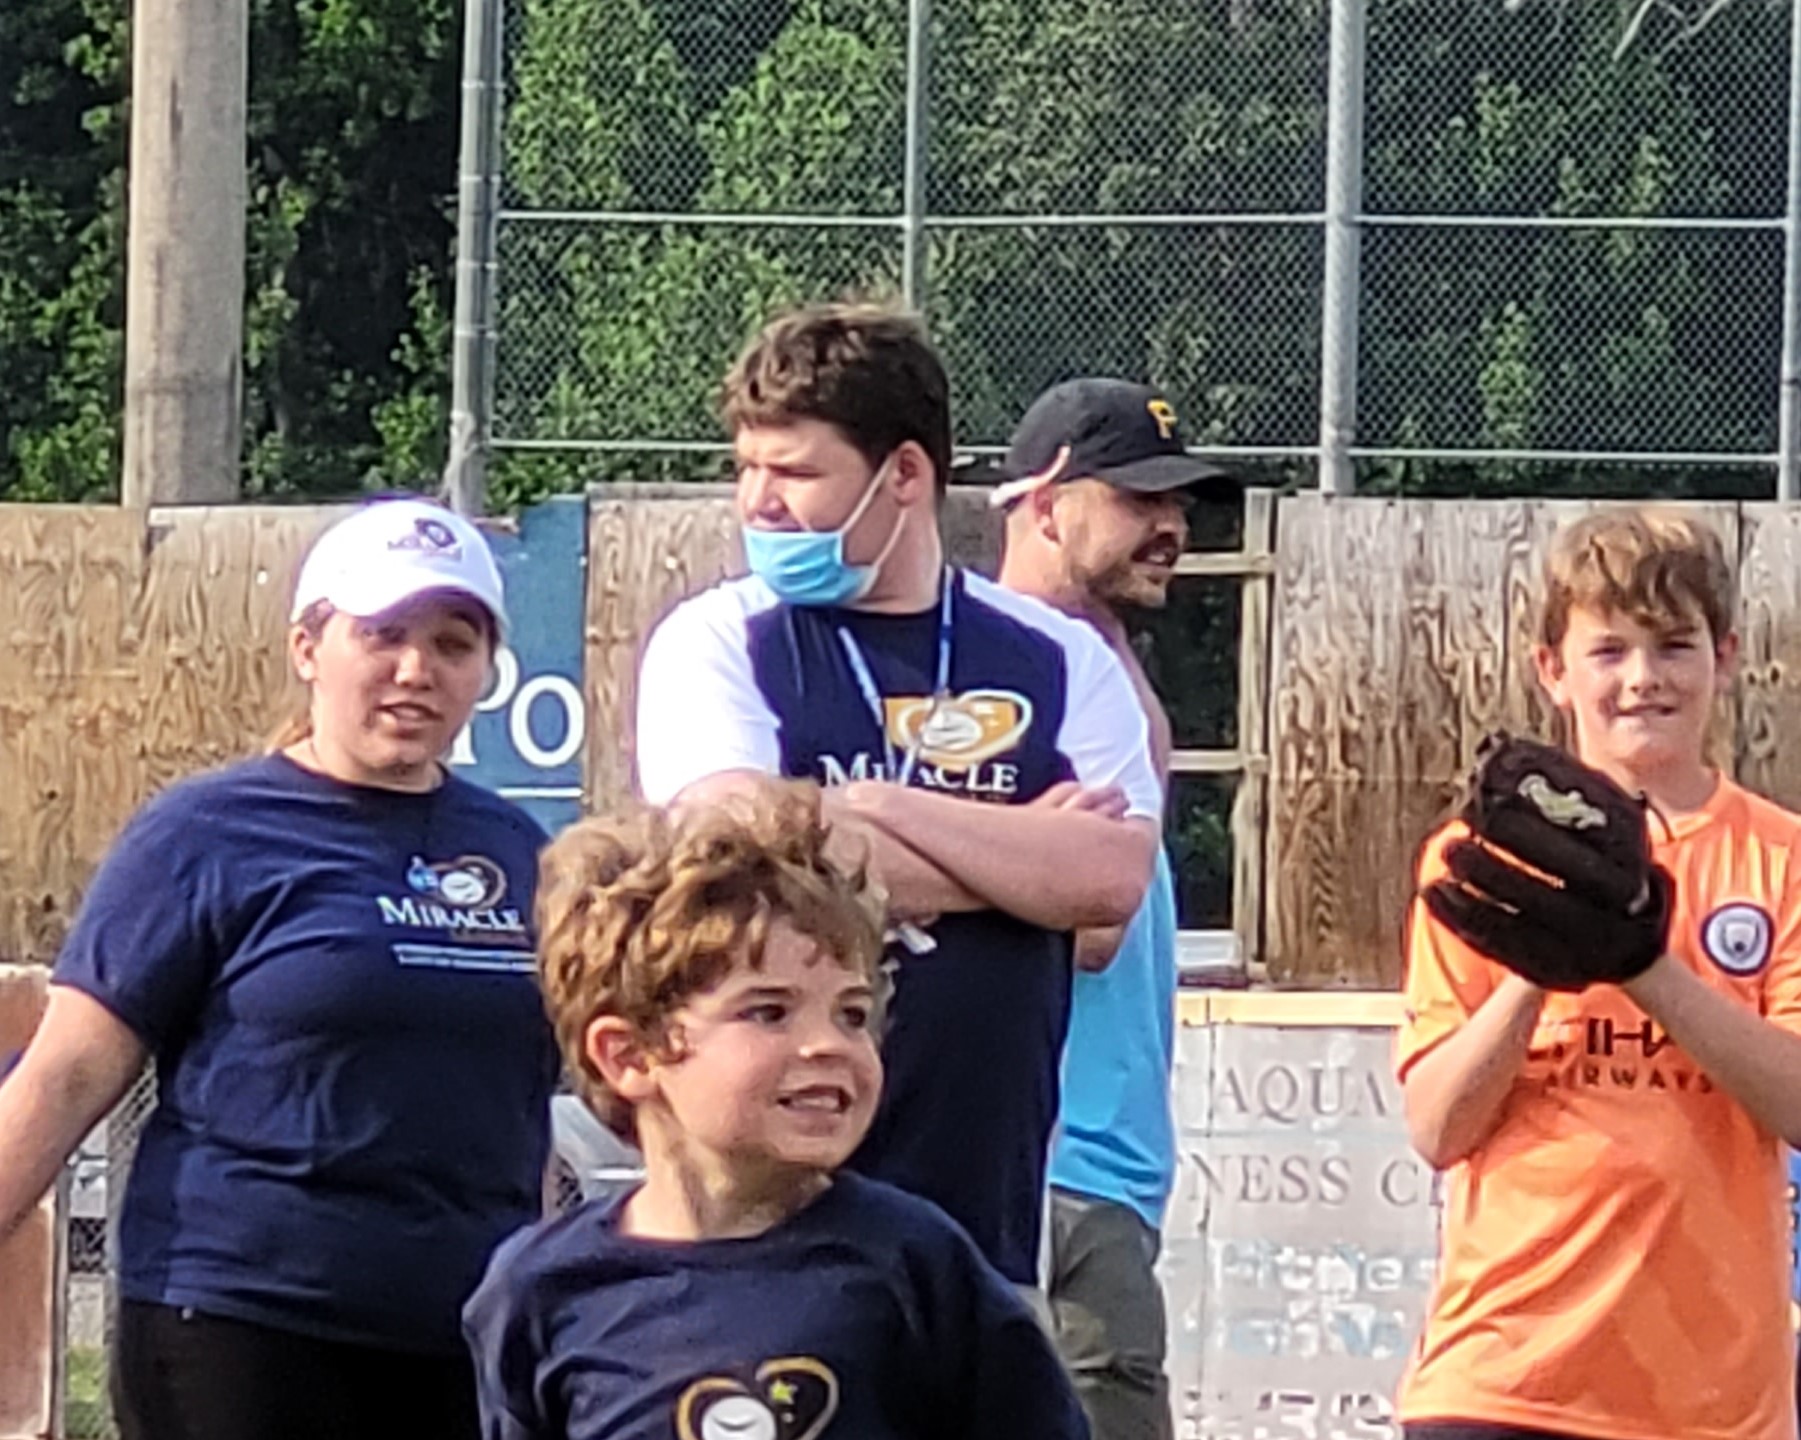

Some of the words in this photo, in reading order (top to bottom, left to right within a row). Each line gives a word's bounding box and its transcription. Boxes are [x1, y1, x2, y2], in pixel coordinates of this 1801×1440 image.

[817, 753, 1021, 794] MIACLE
[377, 895, 525, 932] MIRACLE
[1178, 1153, 1351, 1207] NESS
